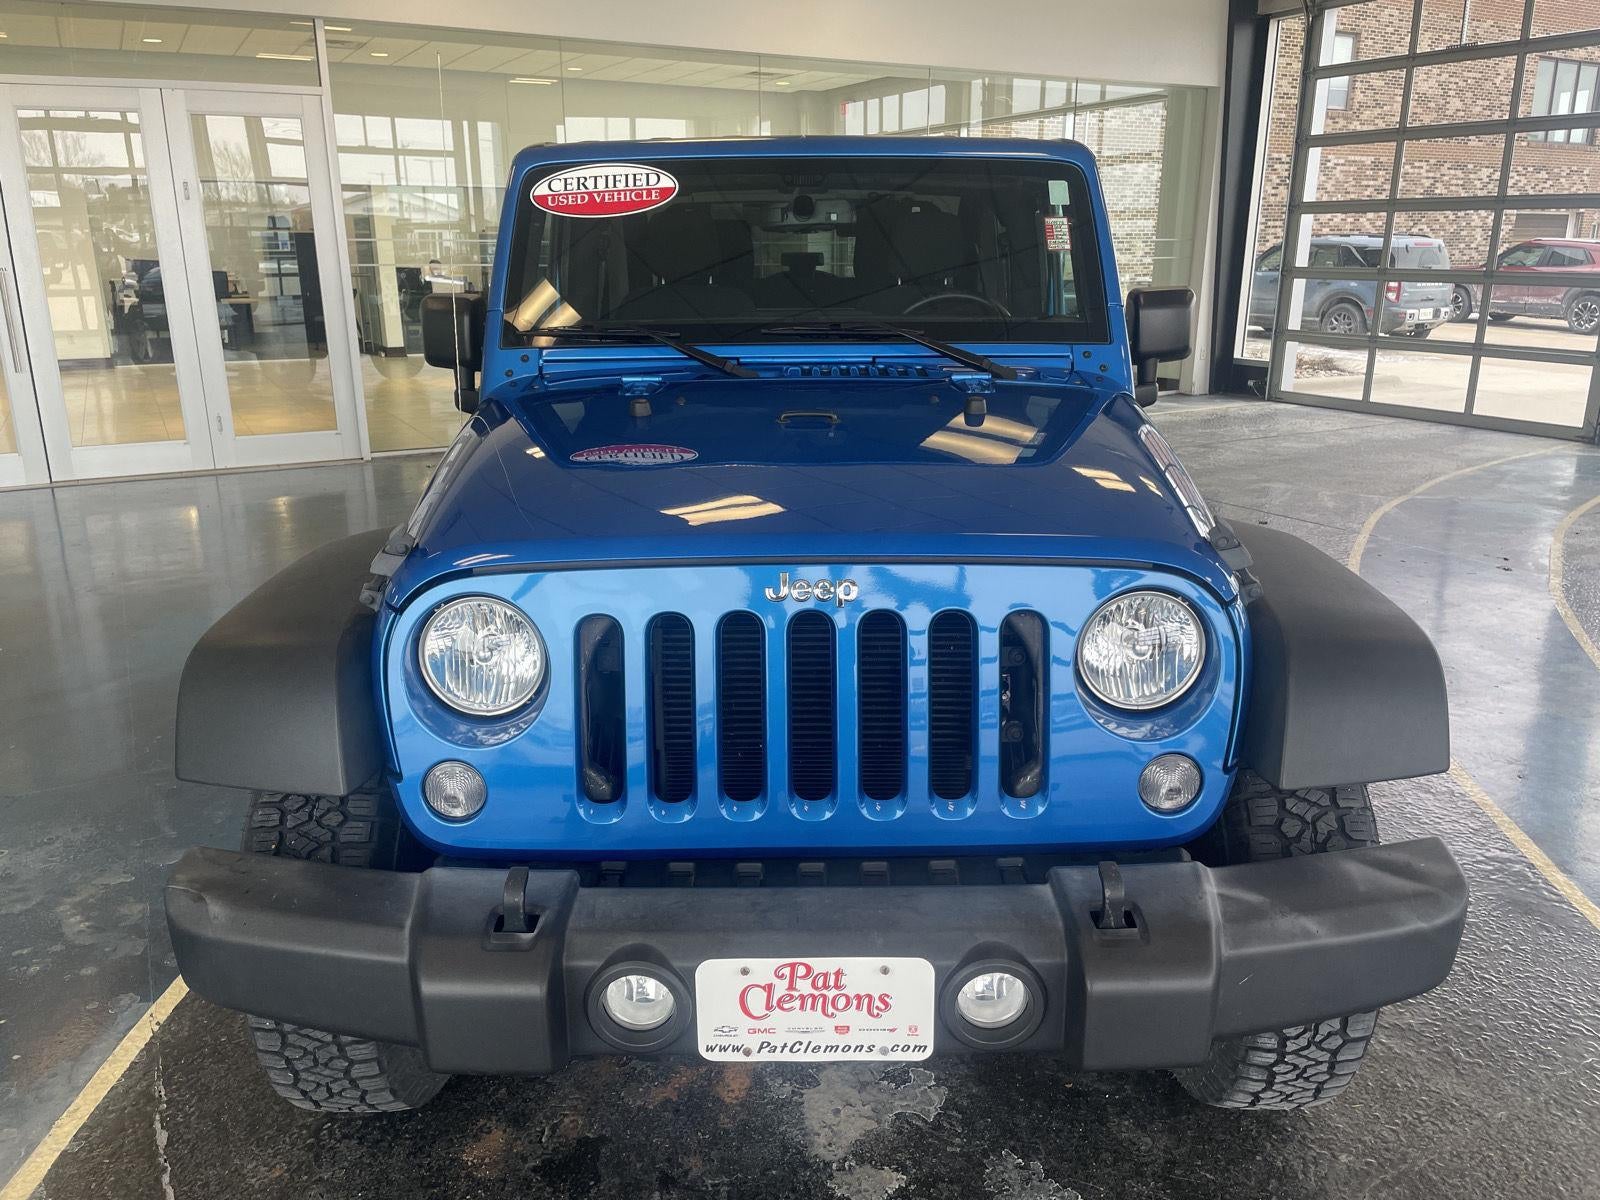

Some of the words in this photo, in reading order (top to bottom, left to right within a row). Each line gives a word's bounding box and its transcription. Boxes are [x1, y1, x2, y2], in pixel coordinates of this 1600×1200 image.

[547, 172, 661, 193] CERTIFIED
[547, 193, 589, 207] USED
[592, 189, 660, 204] VEHICLE
[765, 572, 858, 608] Jeep
[773, 962, 847, 992] Pat
[739, 982, 893, 1021] Clemons
[705, 1040, 928, 1054] wwwPatClemonscom
